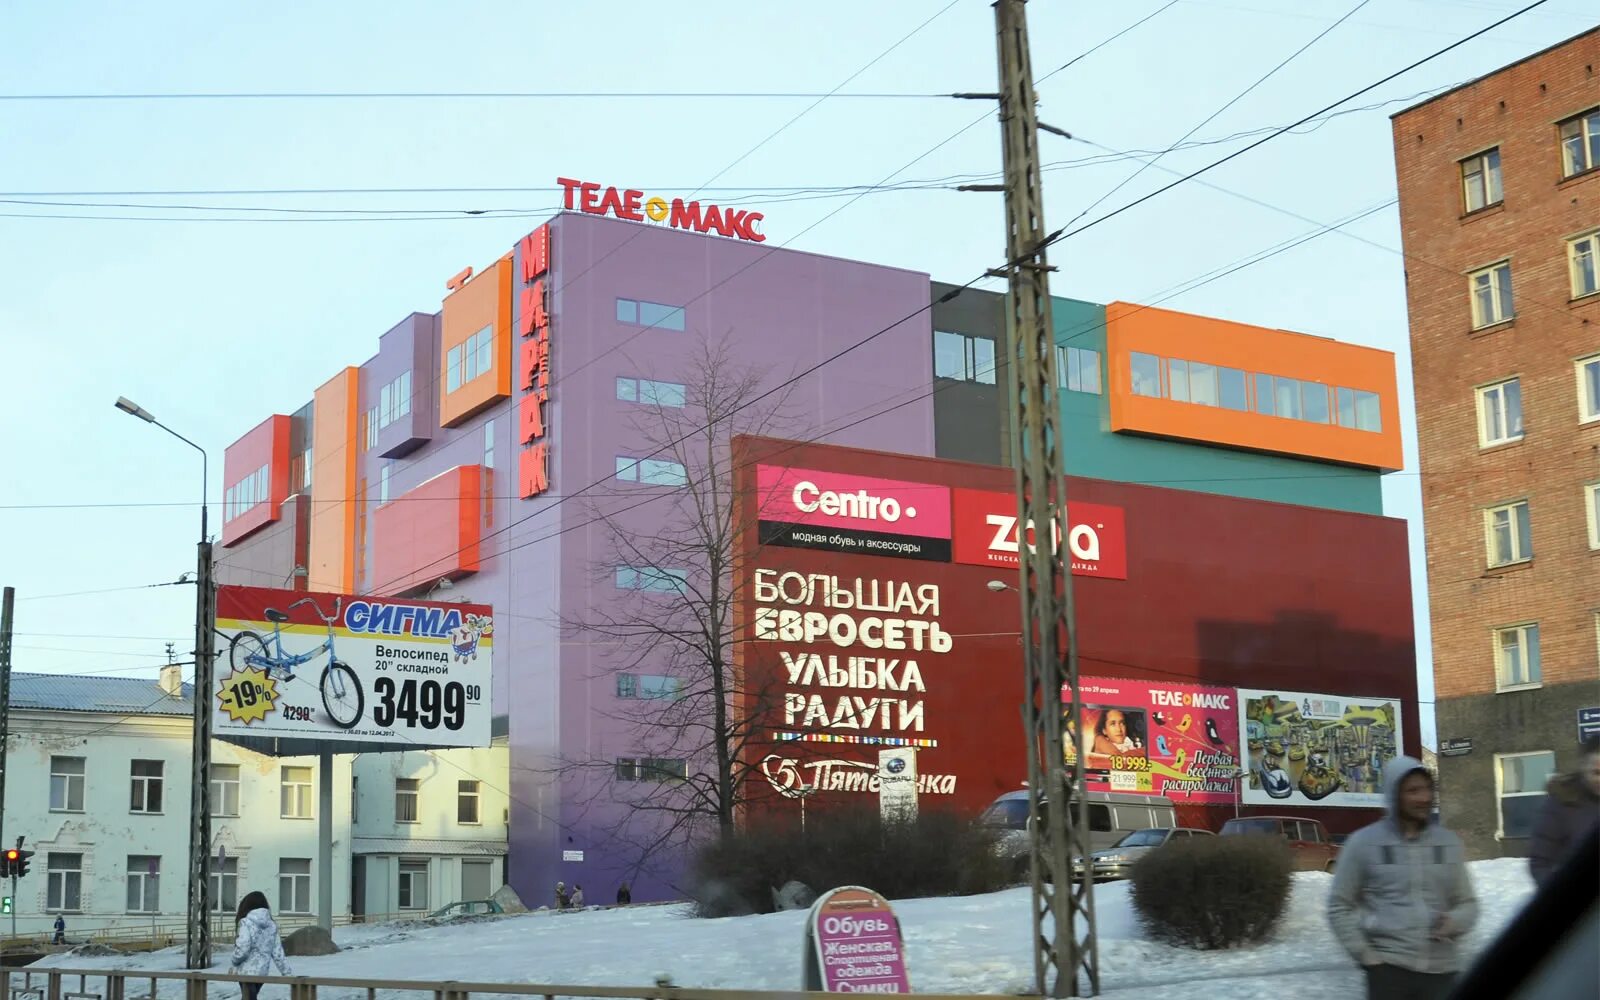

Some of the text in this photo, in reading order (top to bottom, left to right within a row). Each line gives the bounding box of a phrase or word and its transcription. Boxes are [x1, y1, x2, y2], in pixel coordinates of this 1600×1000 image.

[792, 532, 921, 554] модная обувь и аксессуары
[754, 568, 940, 616] БОЛЬШАЯ
[345, 601, 462, 638] СИГМА
[754, 607, 953, 653] ЕВРОСЕТЬ
[376, 645, 449, 664] Велосипед
[396, 662, 449, 675] складной
[779, 651, 927, 693] УЛЫБКА
[224, 680, 272, 709] -19%
[373, 676, 465, 731] 3499
[784, 692, 924, 732] РАДУГИ
[1193, 750, 1232, 765] Первая
[1186, 765, 1233, 778] весенняя
[1162, 778, 1233, 797] распродажа!
[824, 916, 889, 936] Обувь
[825, 953, 898, 965] Спортивная
[836, 963, 892, 977] одежда
[837, 981, 899, 993] Сумки
